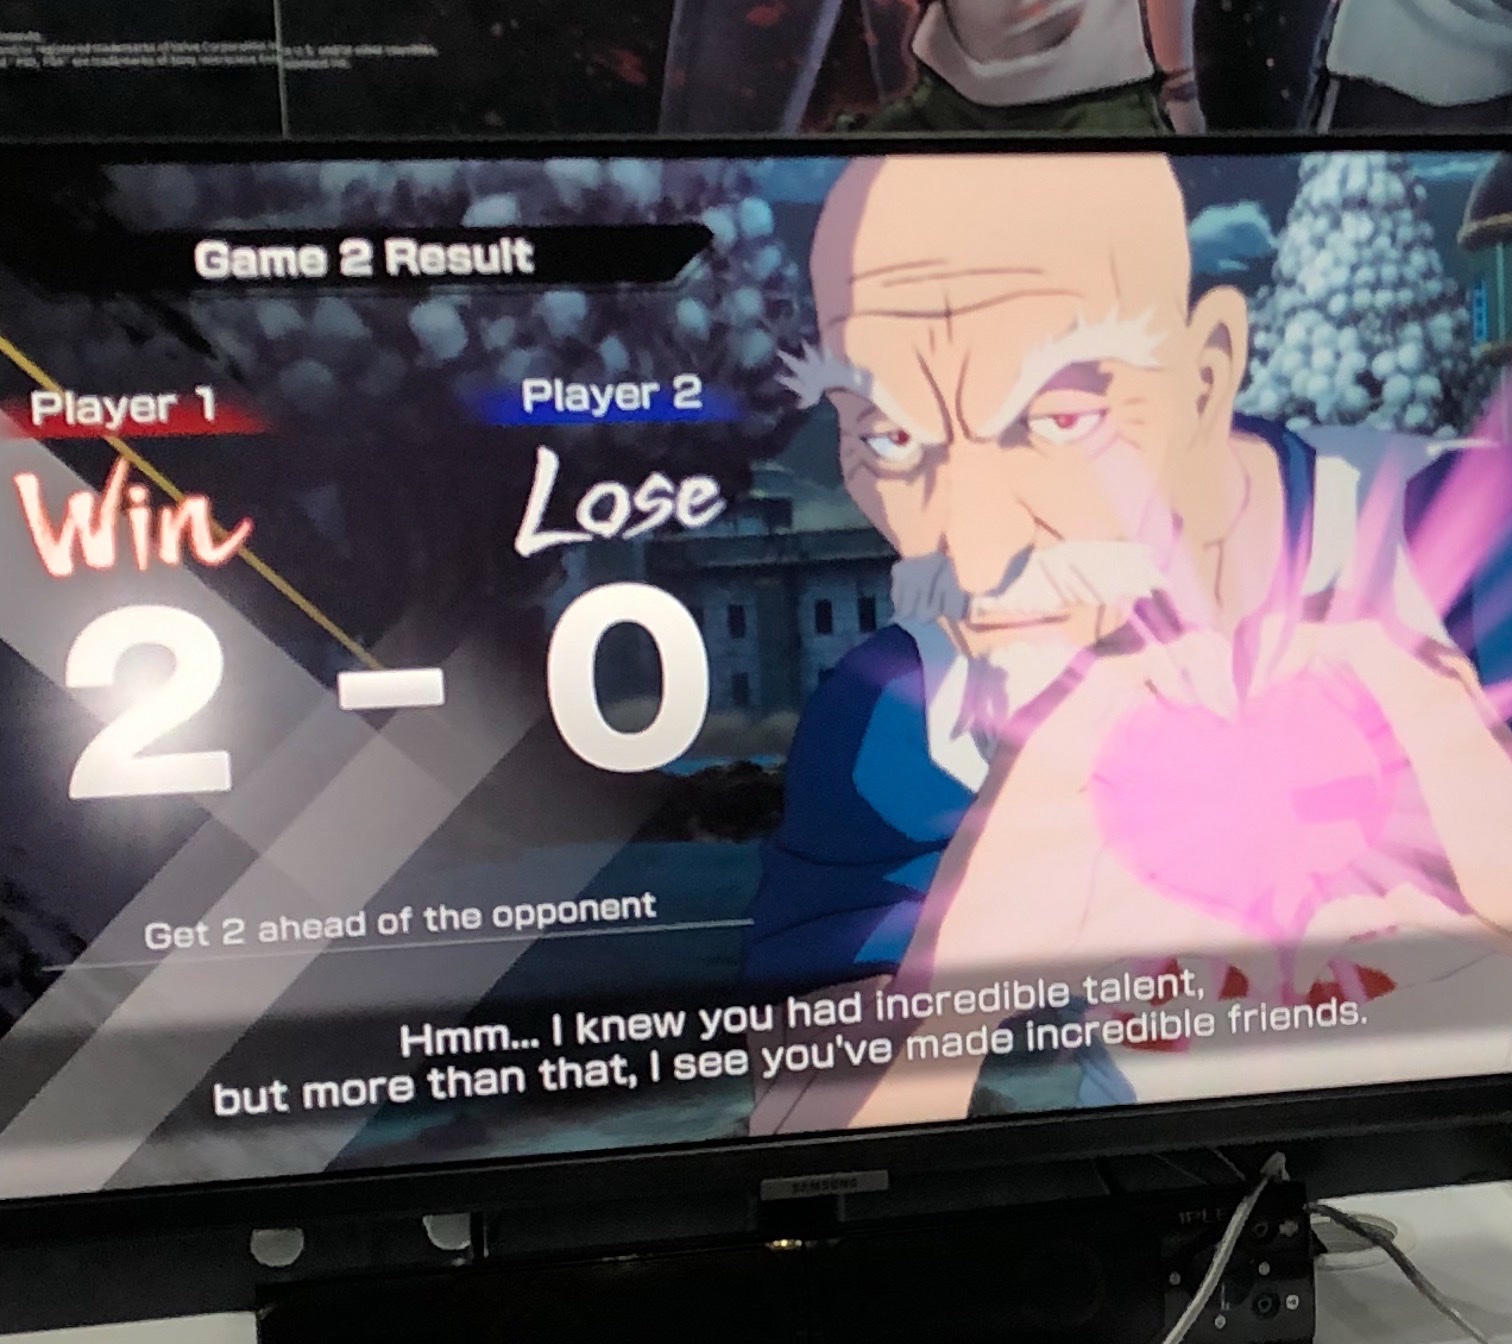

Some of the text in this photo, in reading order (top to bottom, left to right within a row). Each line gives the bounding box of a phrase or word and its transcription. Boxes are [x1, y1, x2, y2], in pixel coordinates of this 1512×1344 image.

[195, 236, 534, 280] Game 2 Result
[31, 386, 216, 429] Player 1
[522, 375, 703, 416] Player 2
[14, 458, 254, 577] Win
[514, 446, 725, 558] Lose
[65, 605, 232, 800] 2
[548, 582, 710, 773] 0
[144, 892, 657, 950] Get 2 ahead of the opponent
[213, 996, 1368, 1117] but more than that, I see you've made incredible friends.
[400, 968, 1205, 1058] Hmm... I knew you had incredible talent,
